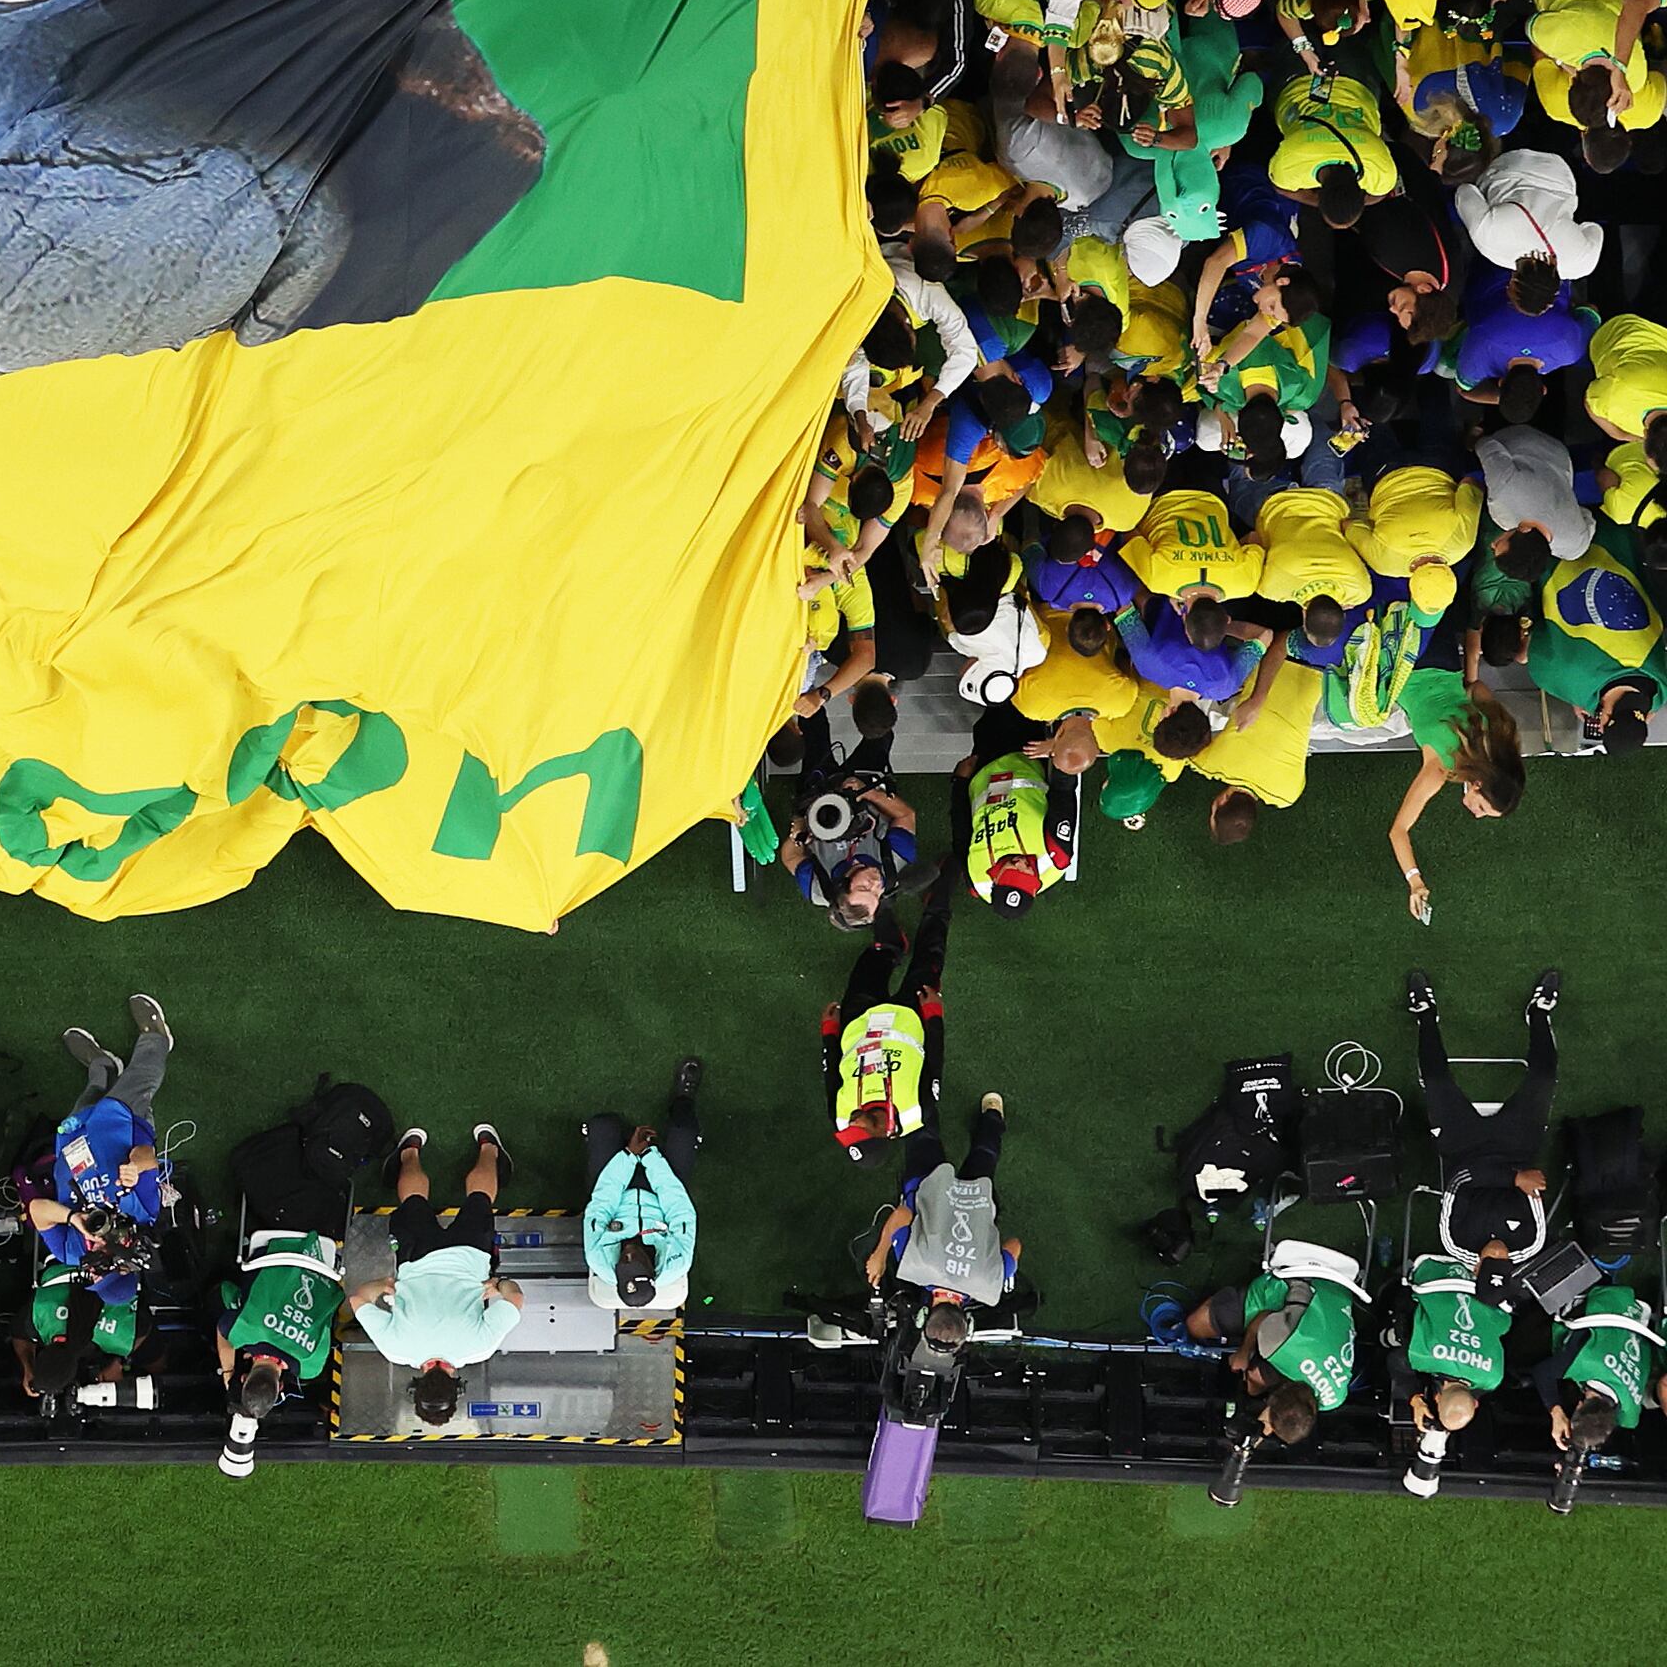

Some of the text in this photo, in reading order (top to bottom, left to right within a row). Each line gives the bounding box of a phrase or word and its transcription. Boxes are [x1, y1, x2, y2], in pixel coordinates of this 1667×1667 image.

[1174, 513, 1225, 548] 10
[1170, 548, 1234, 562] NEYMAR JR
[943, 1239, 976, 1260] 767
[943, 1256, 971, 1278] HB
[54, 1303, 116, 1333] PHO
[262, 1312, 316, 1352] PHOTO
[1447, 1327, 1481, 1348] 932
[1321, 1352, 1348, 1388] 723
[1431, 1342, 1493, 1372] PHOTO
[1298, 1357, 1338, 1406] PHOTO
[1602, 1351, 1642, 1404] PHOTO
